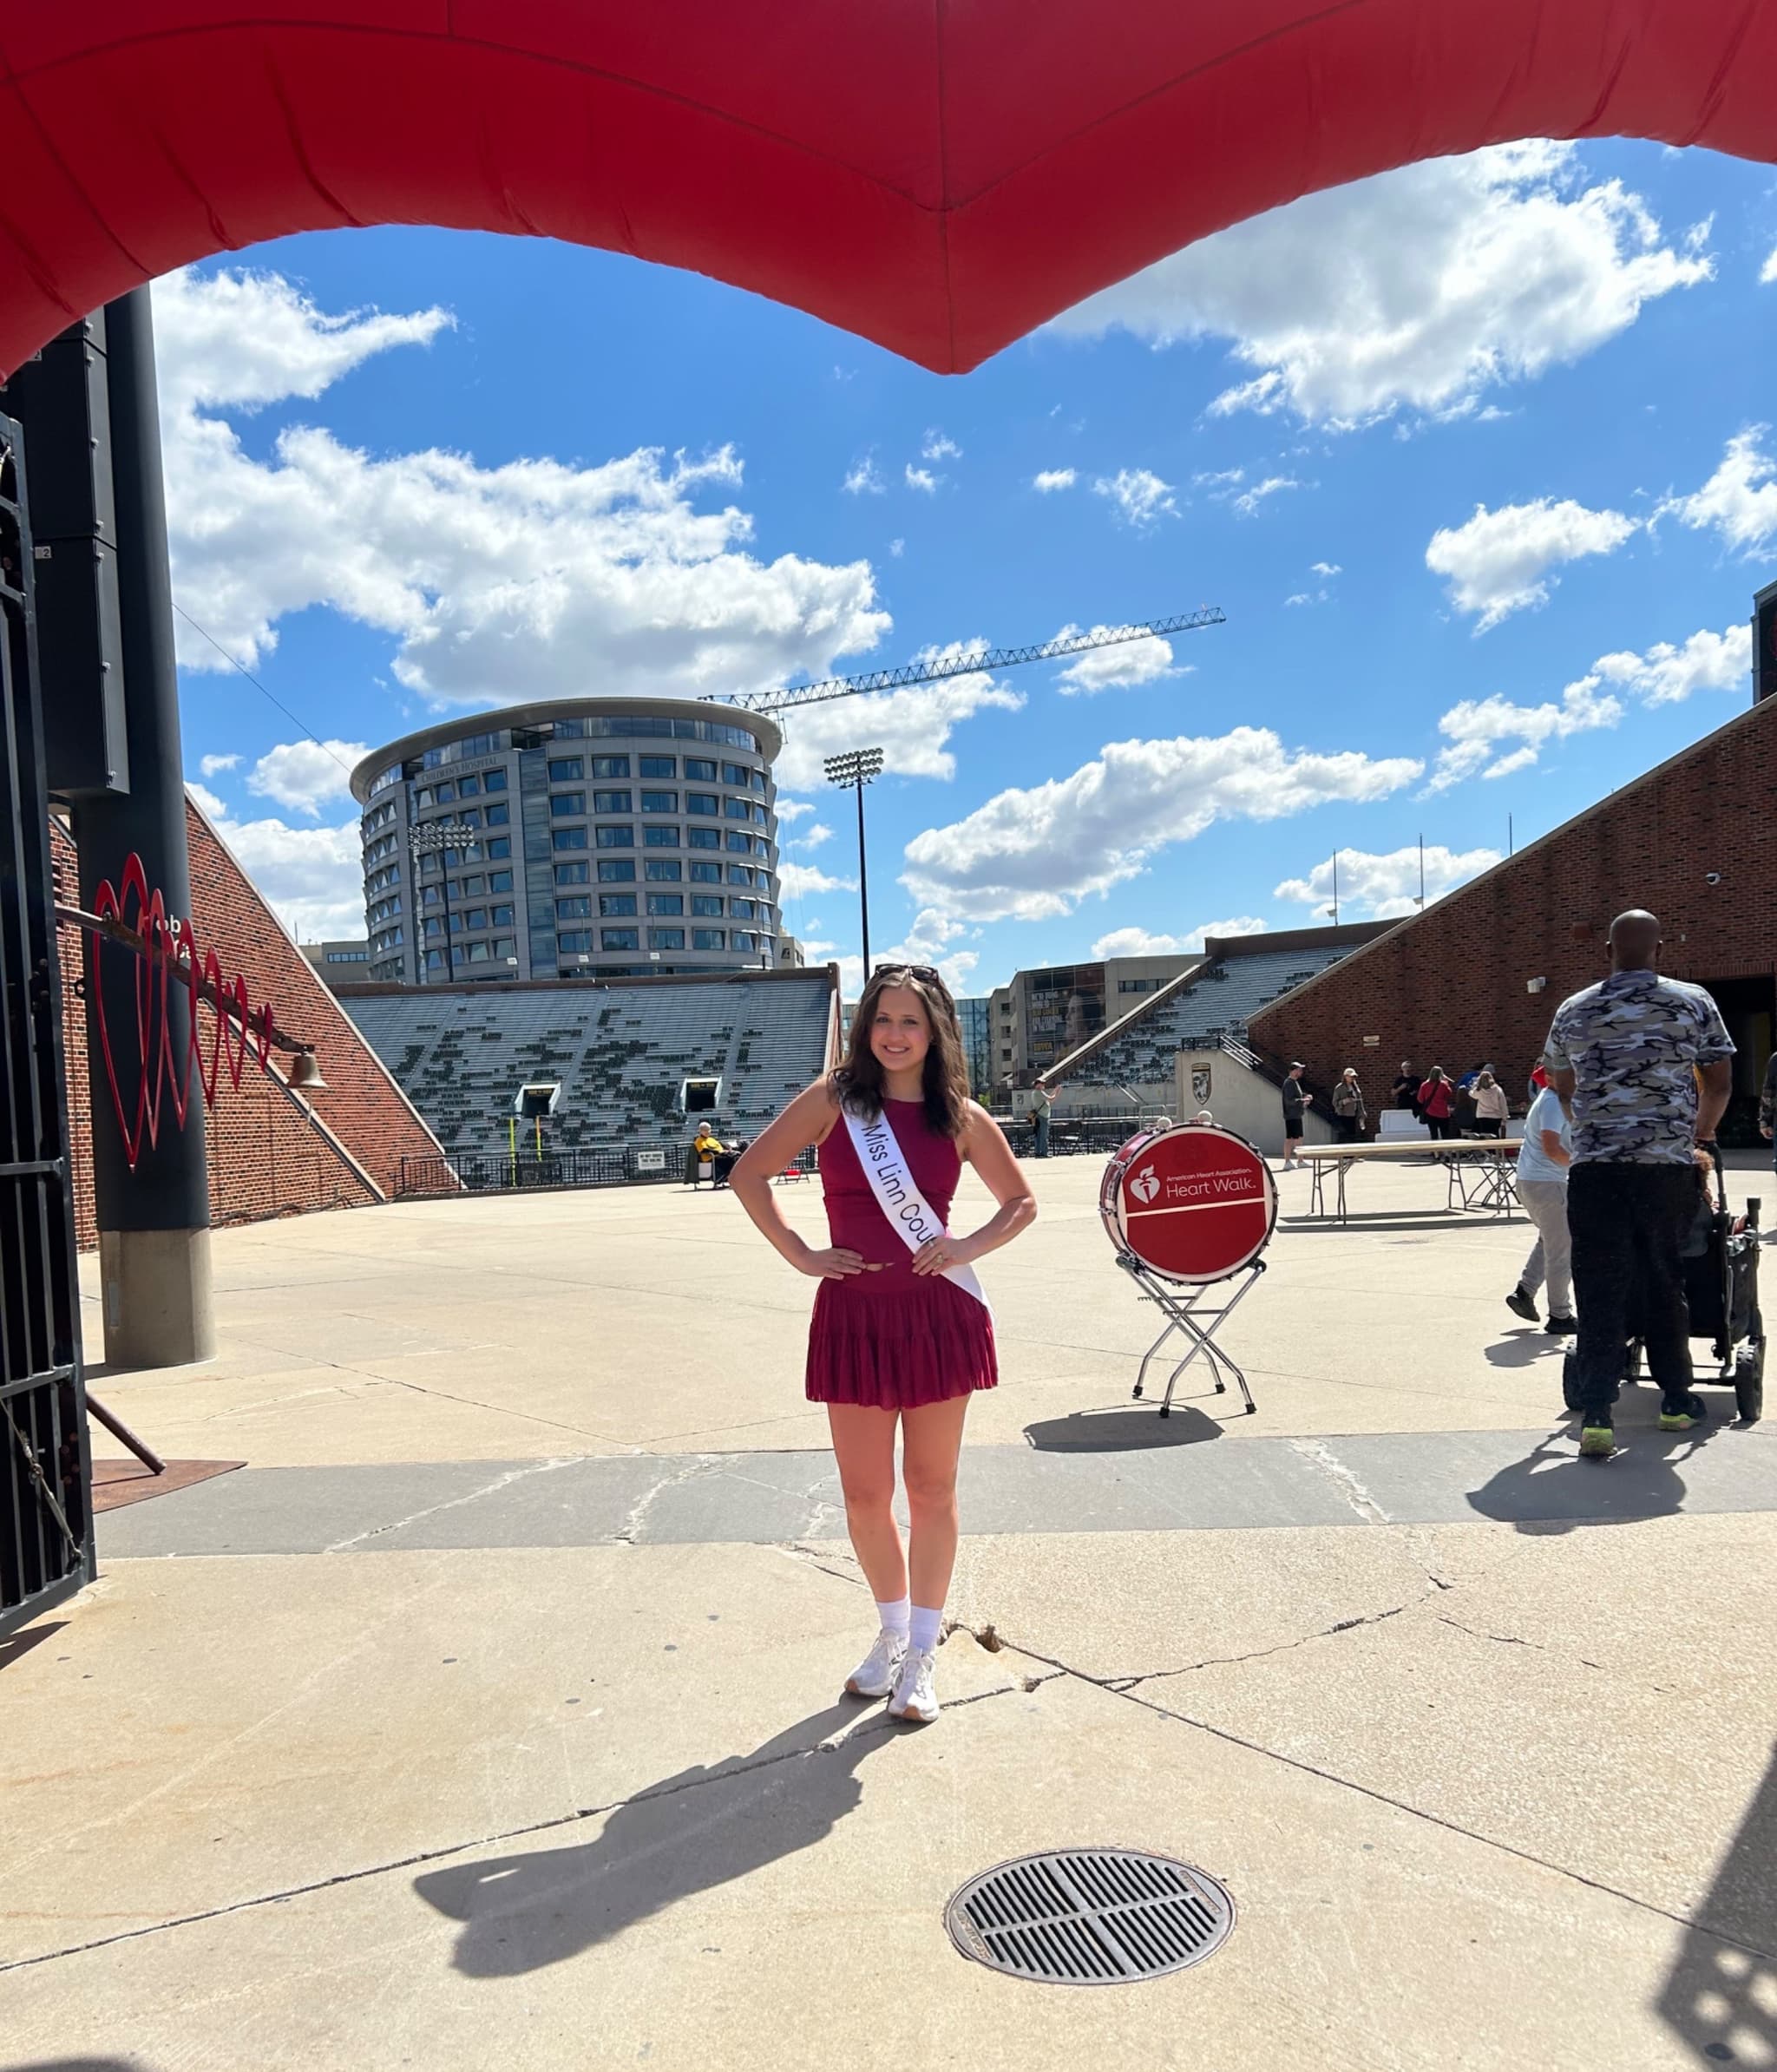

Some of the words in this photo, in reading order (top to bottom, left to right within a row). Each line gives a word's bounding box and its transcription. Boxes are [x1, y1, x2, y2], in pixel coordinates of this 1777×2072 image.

[43, 548, 50, 557] 2
[1197, 1170, 1215, 1179] Heart
[861, 1124, 889, 1162] Miss
[876, 1163, 907, 1205] Linn
[900, 1203, 934, 1244] Cou
[1166, 1181, 1210, 1198] Heart
